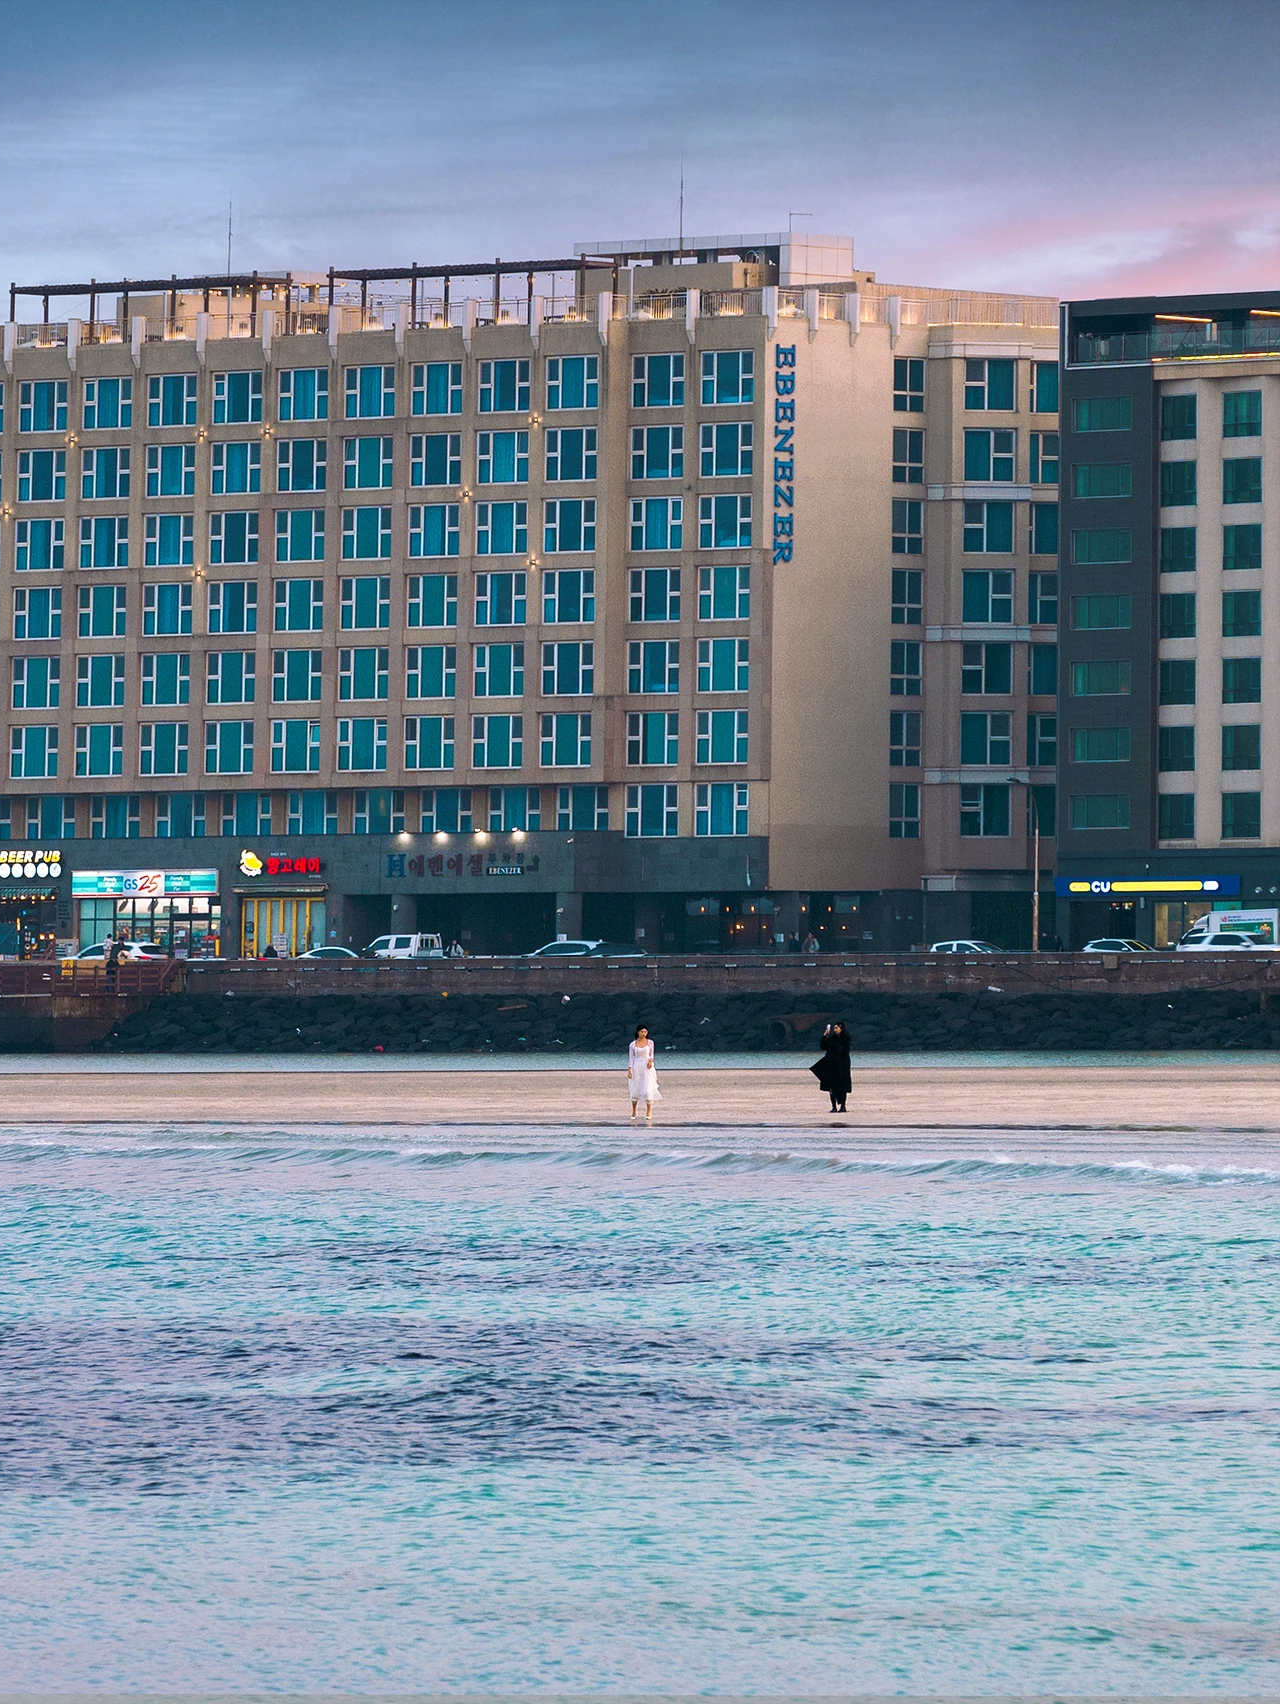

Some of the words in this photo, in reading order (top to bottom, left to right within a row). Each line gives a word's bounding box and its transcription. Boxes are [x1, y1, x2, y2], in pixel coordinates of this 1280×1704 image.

[773, 343, 796, 566] EBENEZER
[34, 850, 61, 863] PUB
[408, 853, 484, 878] 에벤에셀
[488, 866, 522, 875] EBENEZER
[123, 874, 162, 893] GS25
[1090, 880, 1111, 893] CU
